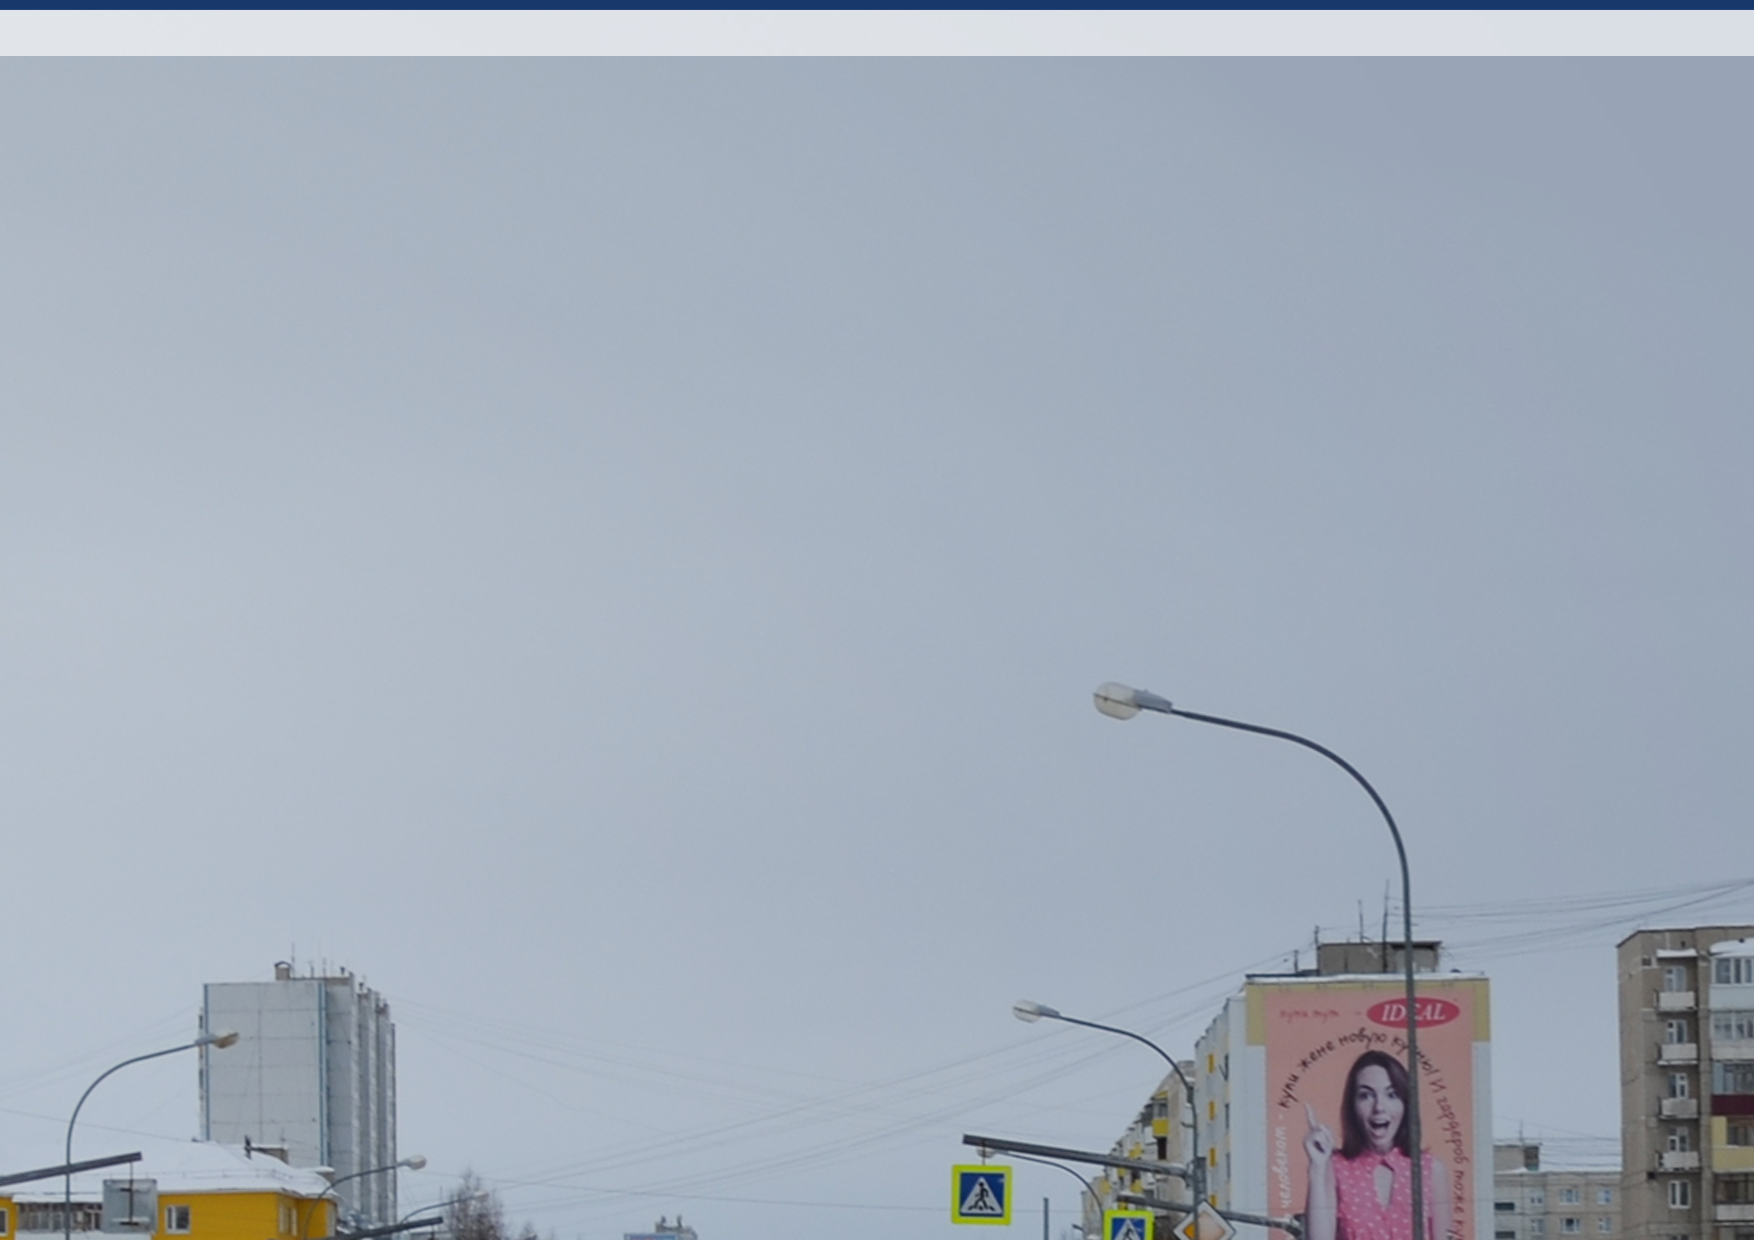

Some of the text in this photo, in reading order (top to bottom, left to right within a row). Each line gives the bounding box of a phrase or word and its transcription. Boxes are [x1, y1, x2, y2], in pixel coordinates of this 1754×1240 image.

[1277, 1073, 1299, 1109] купи
[1297, 1041, 1335, 1072] жене
[1338, 1026, 1388, 1049] новую
[1391, 1034, 1441, 1077] куню!
[1436, 1096, 1471, 1165] гардероб
